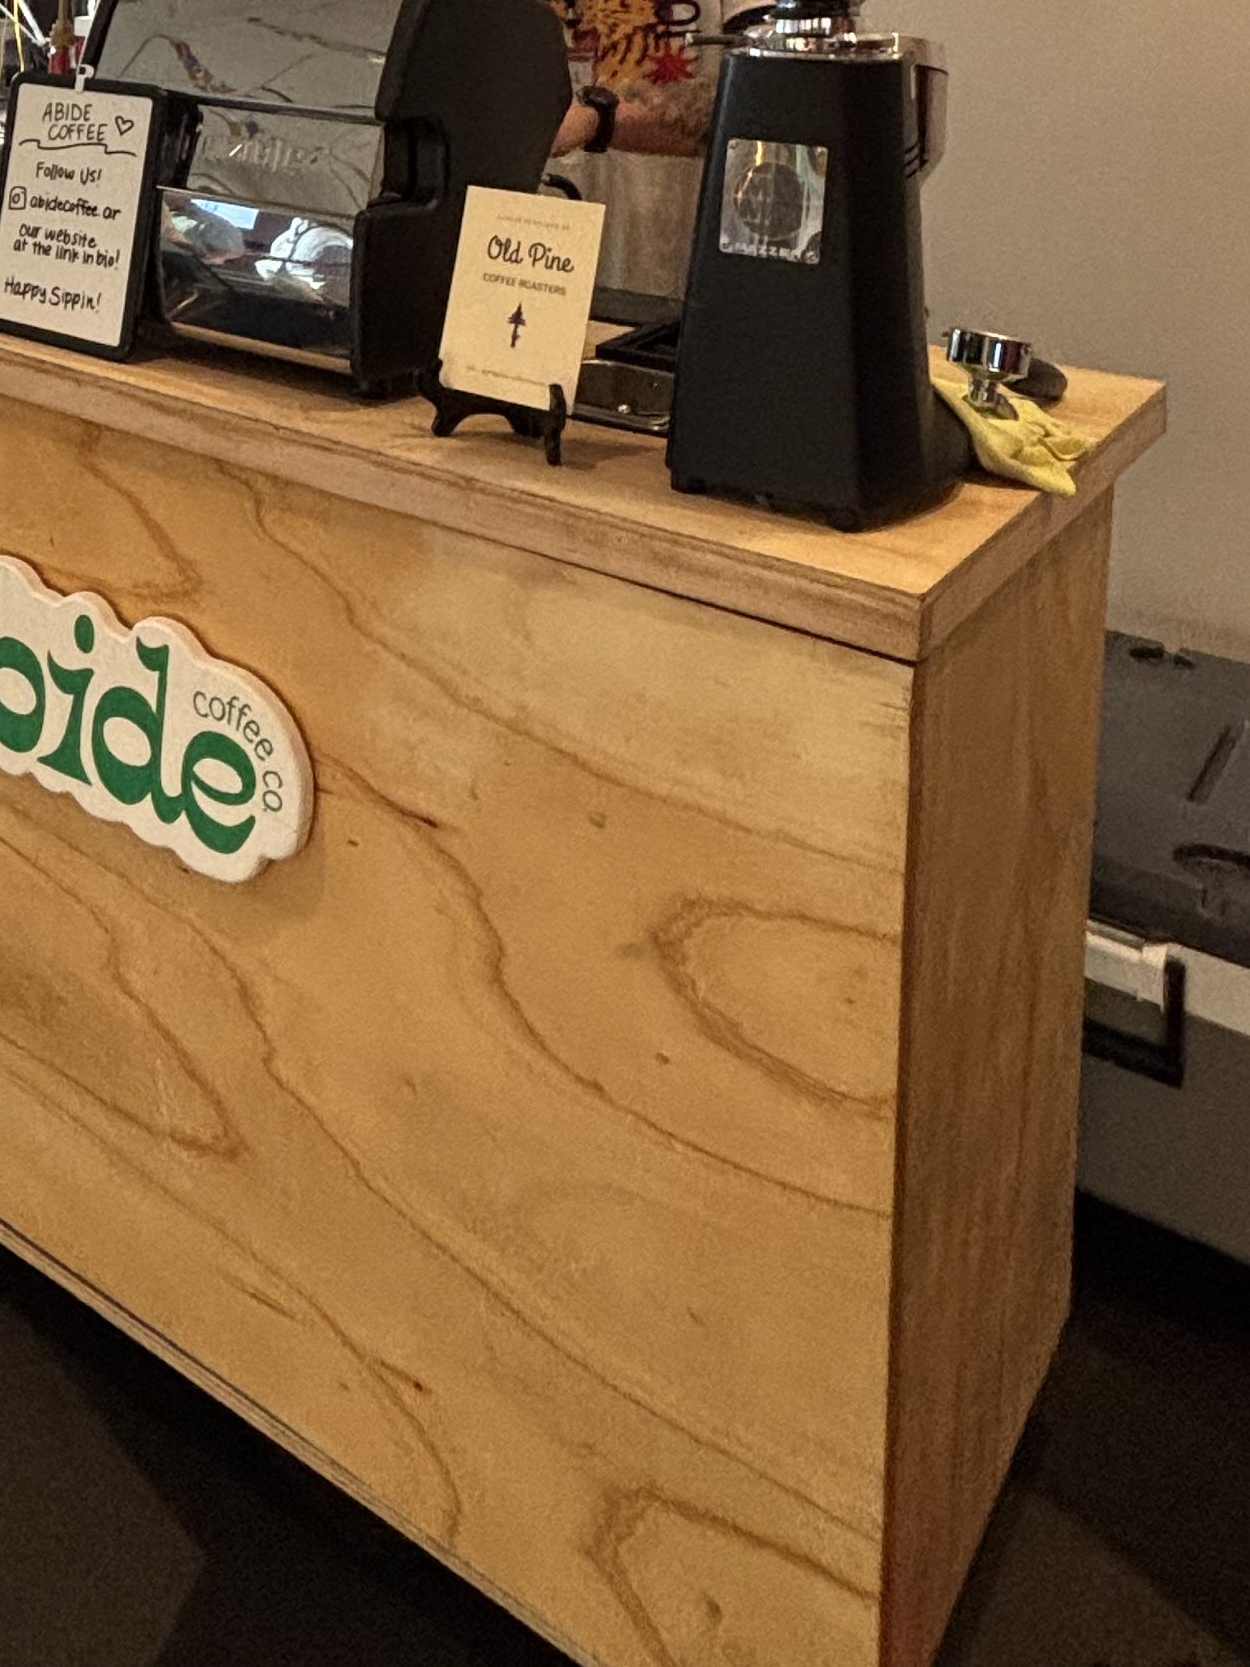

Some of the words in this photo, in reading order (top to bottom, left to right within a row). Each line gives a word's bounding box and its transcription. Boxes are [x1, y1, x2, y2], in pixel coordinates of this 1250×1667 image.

[42, 102, 93, 122] ABIDE
[48, 123, 108, 143] COFFEE
[35, 161, 75, 180] Follow
[19, 223, 41, 239] our
[45, 229, 97, 249] website
[13, 238, 28, 252] at
[32, 241, 52, 256] the
[55, 245, 79, 263] link
[82, 250, 94, 265] in
[96, 248, 120, 271] bio!
[487, 234, 524, 265] Old
[528, 242, 575, 274] Pine
[4, 276, 47, 304] Happy
[49, 286, 102, 313] Sippin!
[483, 272, 516, 288] COFFEE
[518, 277, 567, 297] ROASTERS
[193, 690, 274, 762] coffee
